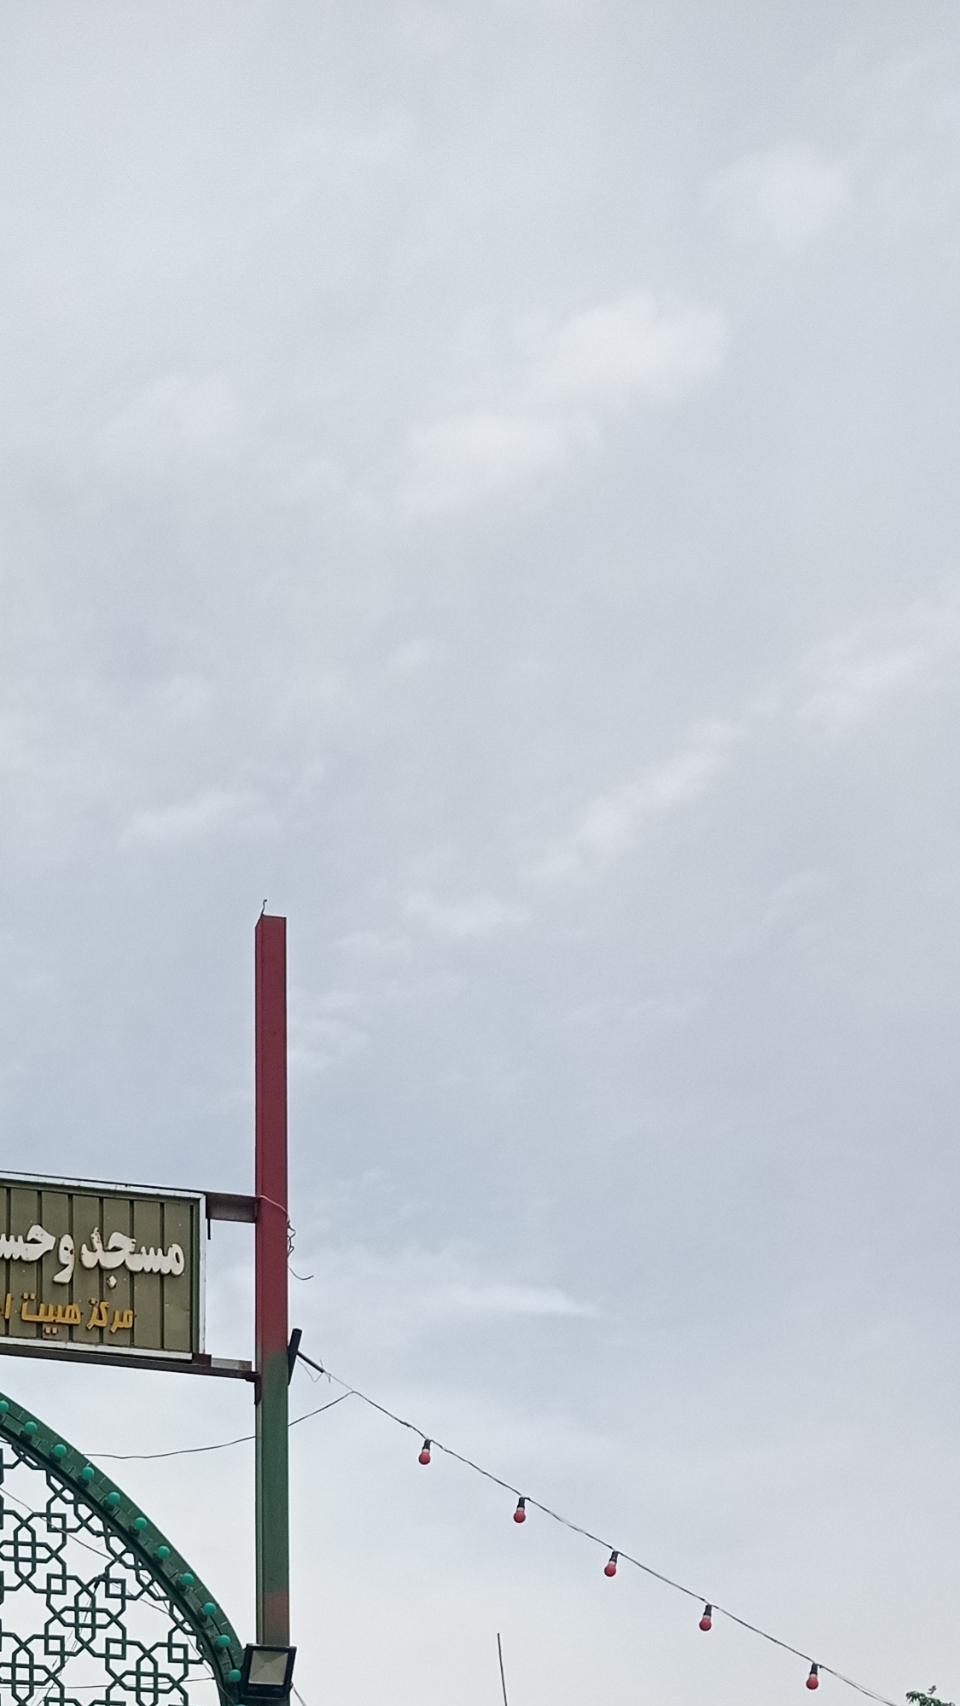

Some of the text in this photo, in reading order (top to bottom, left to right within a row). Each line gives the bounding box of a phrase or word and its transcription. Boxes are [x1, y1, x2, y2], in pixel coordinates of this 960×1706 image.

[52, 1233, 75, 1284] و
[81, 1227, 185, 1288] مسجد
[86, 1297, 136, 1334] مرکز
